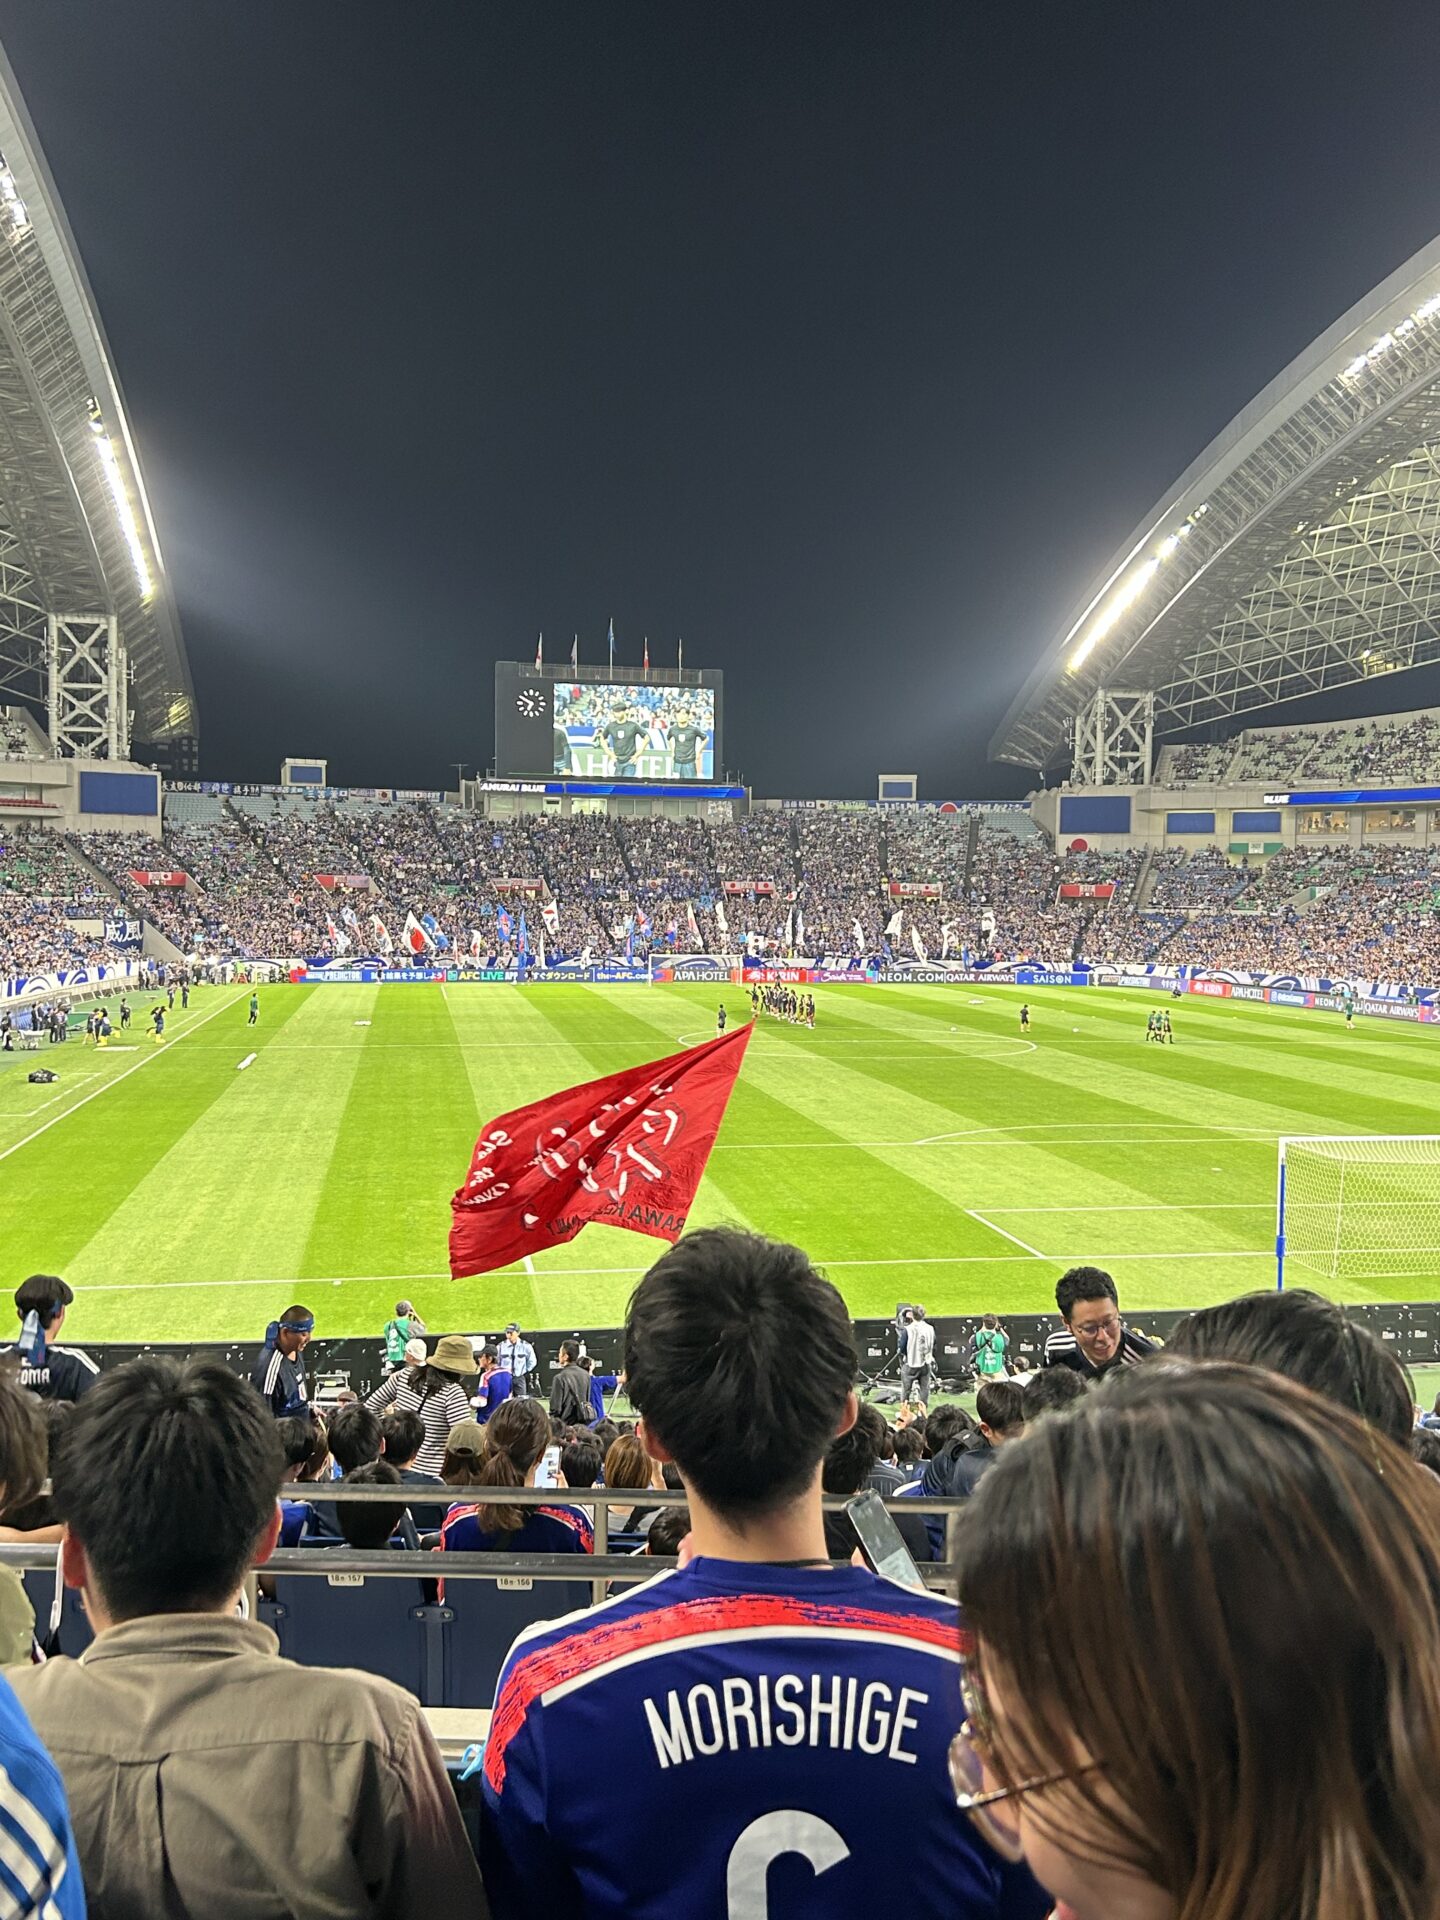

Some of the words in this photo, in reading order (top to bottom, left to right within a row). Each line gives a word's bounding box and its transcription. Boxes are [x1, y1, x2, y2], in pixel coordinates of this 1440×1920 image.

[480, 783, 520, 791] AMURAI
[521, 784, 546, 792] BLUE
[105, 920, 143, 942] 威風
[459, 971, 480, 980] AFC
[481, 971, 504, 980] LIVE
[673, 970, 696, 981] APA
[696, 970, 731, 981] HOTEL
[766, 971, 799, 981] KIRIN
[878, 972, 944, 982] NEOM.COM
[946, 973, 976, 982] QATAR
[977, 973, 1015, 982] AIRWAYS
[1033, 974, 1072, 984] SAISON
[1203, 983, 1223, 995] KIRIN
[1314, 997, 1334, 1007] NEOM
[1365, 1002, 1388, 1014] QATAR
[1389, 1004, 1419, 1018] AIRWAYS
[643, 1674, 929, 1769] MORISHIGE
